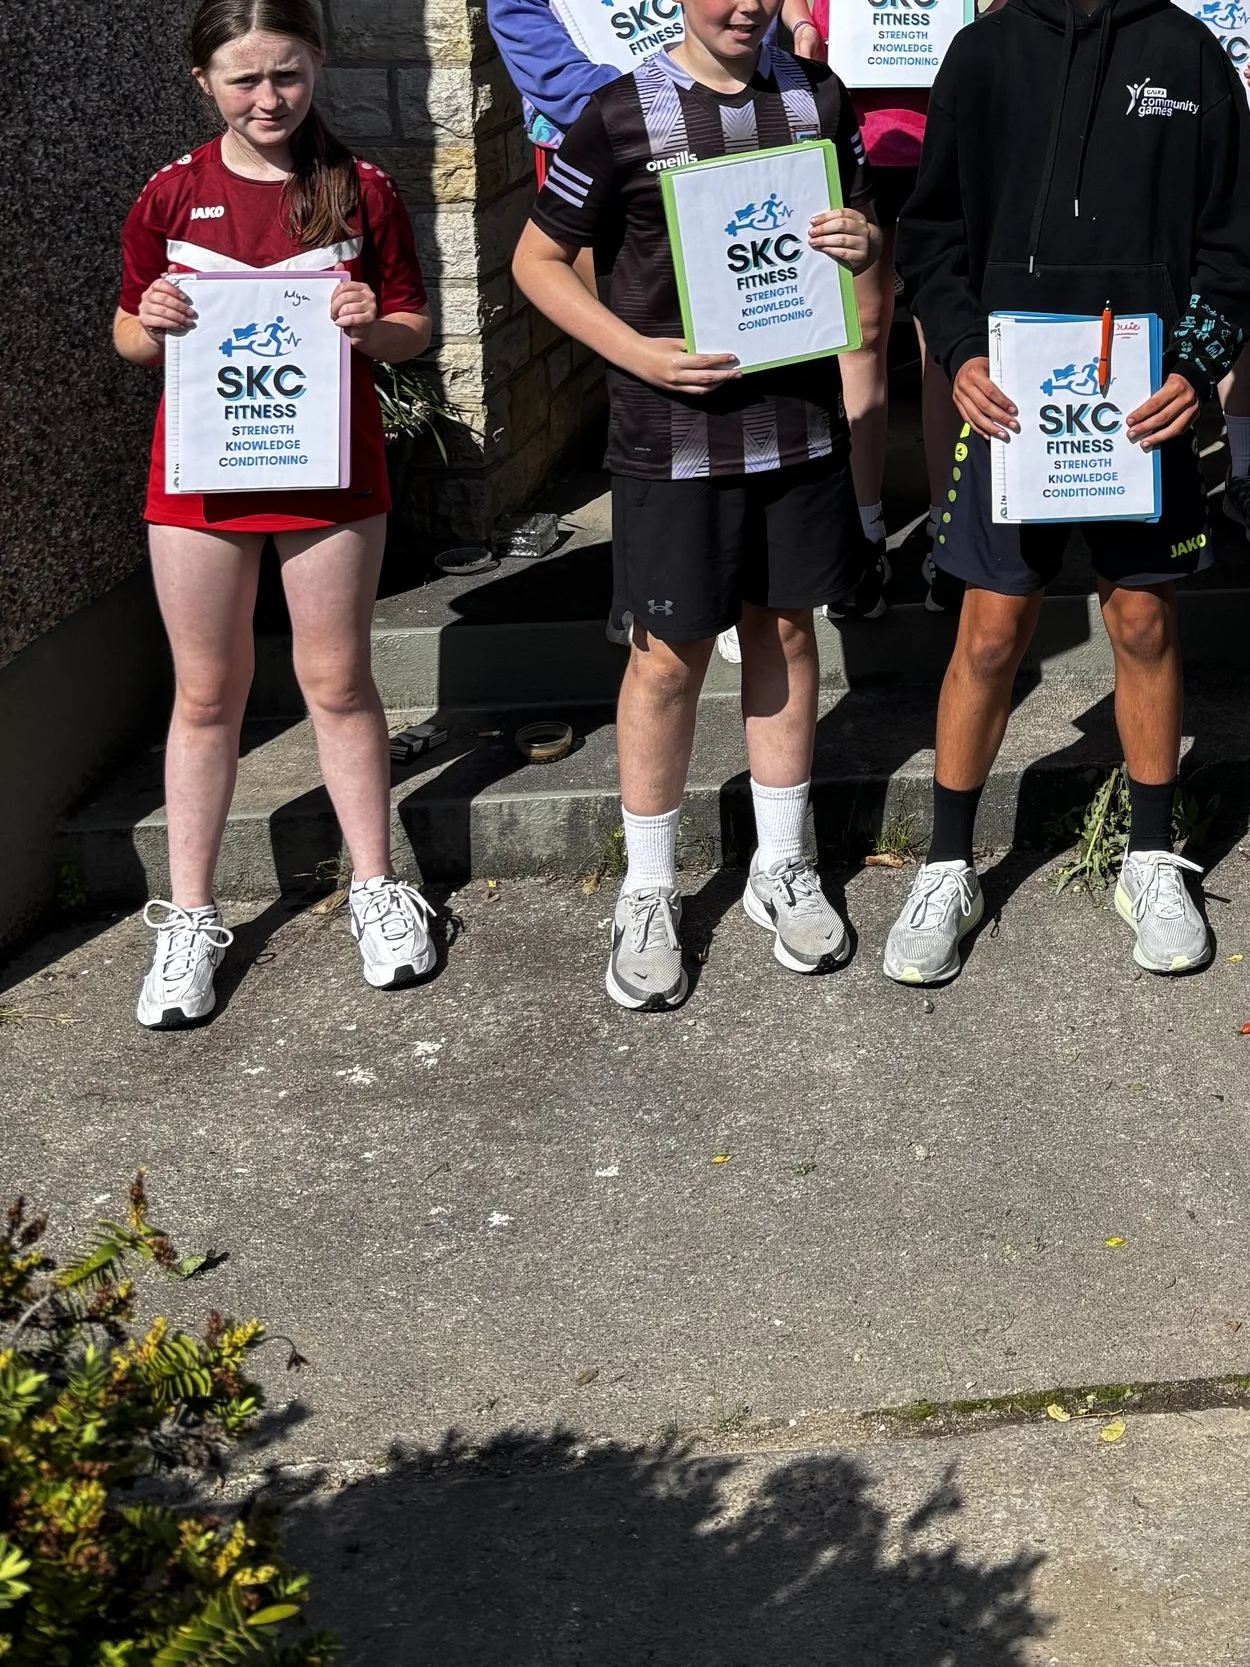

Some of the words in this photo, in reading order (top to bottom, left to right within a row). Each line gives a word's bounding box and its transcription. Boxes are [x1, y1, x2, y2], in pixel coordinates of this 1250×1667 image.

[872, 13, 930, 26] FITNESS
[629, 22, 684, 55] FITNESS
[878, 31, 928, 39] STRENGTH
[872, 43, 933, 52] KNOWLEDGE
[867, 57, 939, 65] CONDITIONING
[1138, 106, 1173, 117] games
[1141, 98, 1200, 114] community
[190, 206, 225, 221] JAKO
[727, 233, 803, 274] SKC
[736, 267, 798, 291] FITNESS
[745, 285, 798, 303] STRENGTH
[741, 296, 805, 317] KNOWLEDGE
[738, 308, 813, 331] CONDITIONING
[217, 364, 308, 401] SKC
[224, 404, 298, 420] FITNESS
[1039, 402, 1123, 438] SKC
[232, 424, 294, 436] STRENGTH
[225, 439, 300, 451] KNOWLEDGE
[1046, 439, 1114, 455] FITNESS
[219, 455, 308, 467] CONDITIONING
[1054, 458, 1112, 469] STRENGTH
[1048, 472, 1118, 484] KNOWLEDGE
[1043, 486, 1126, 498] CONDITIONING
[1170, 533, 1207, 558] JAKO
